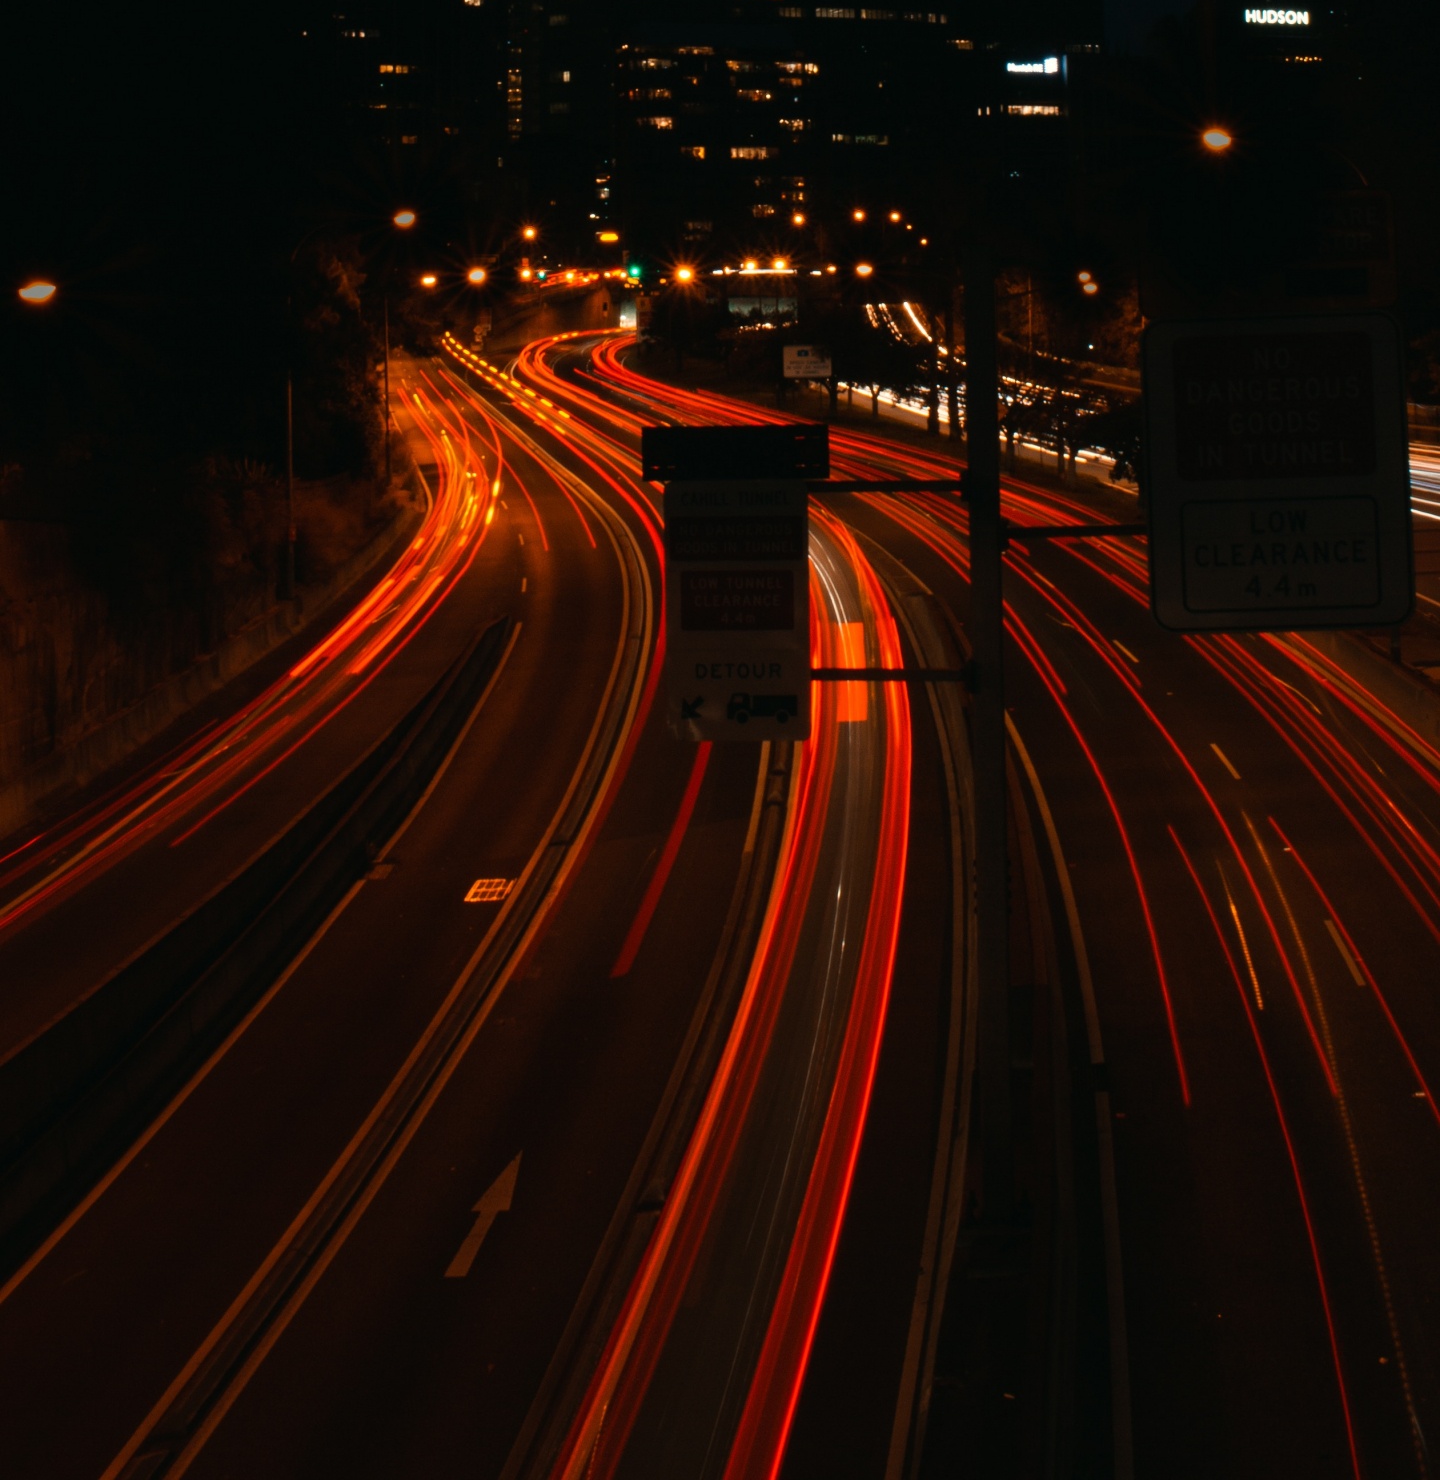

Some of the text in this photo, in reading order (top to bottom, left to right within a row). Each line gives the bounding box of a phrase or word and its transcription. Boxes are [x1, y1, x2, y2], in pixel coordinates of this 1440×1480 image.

[1244, 8, 1310, 26] HUDSON
[1253, 347, 1291, 370] NO
[1186, 375, 1361, 404] DANGEROUS
[1229, 410, 1321, 435] GOODS
[1198, 441, 1354, 467] IN TUNNEL
[738, 490, 788, 505] TUNNEL
[1249, 510, 1307, 534] LOW
[1194, 540, 1367, 567] CLEARANCE
[690, 577, 783, 590] LOW TUNNEL
[694, 594, 781, 607] CLEARANCE
[695, 663, 782, 679] DETOUR
